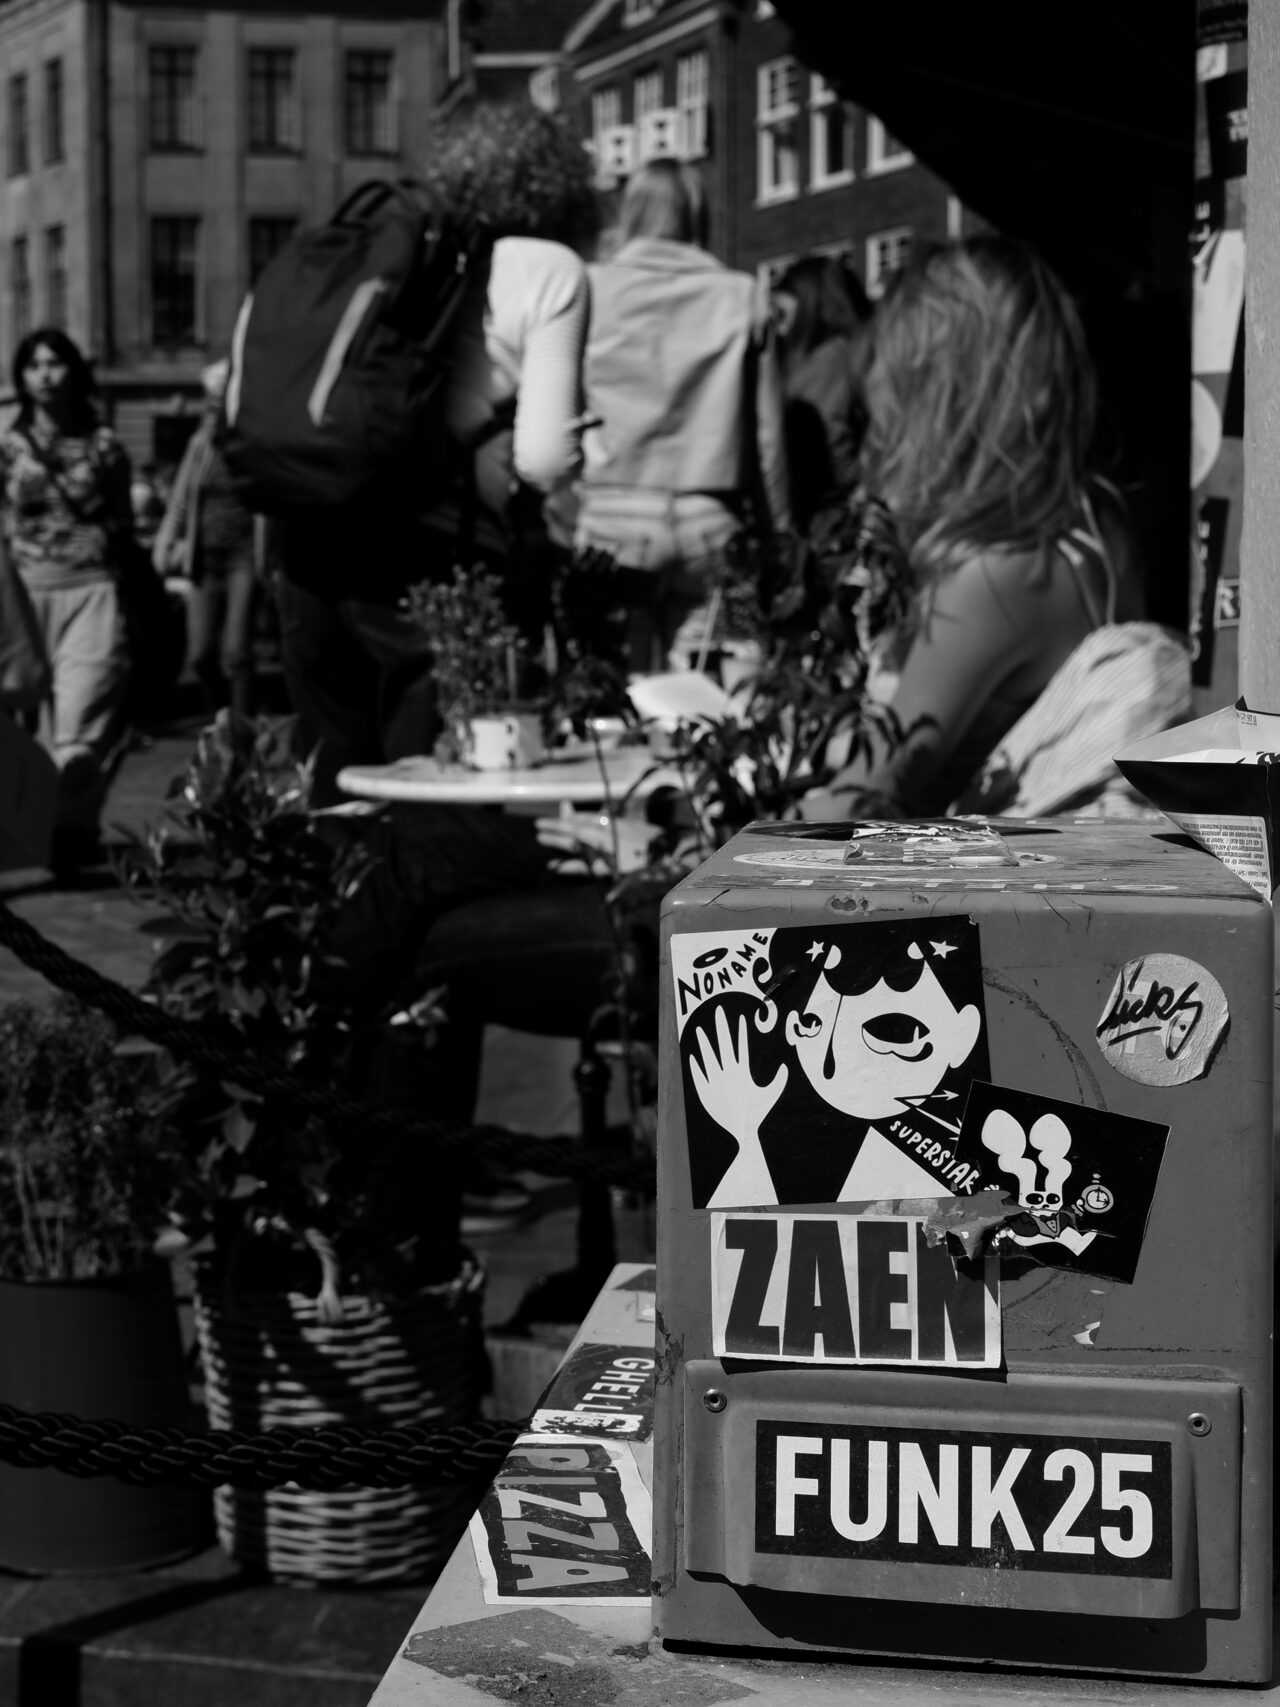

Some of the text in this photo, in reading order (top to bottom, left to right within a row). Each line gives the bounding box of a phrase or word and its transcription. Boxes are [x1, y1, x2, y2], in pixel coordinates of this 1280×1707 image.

[679, 932, 769, 1015] NONAME
[724, 1218, 986, 1362] ZAEN
[494, 1448, 630, 1591] PIZZA
[774, 1435, 1154, 1559] FUNK25
